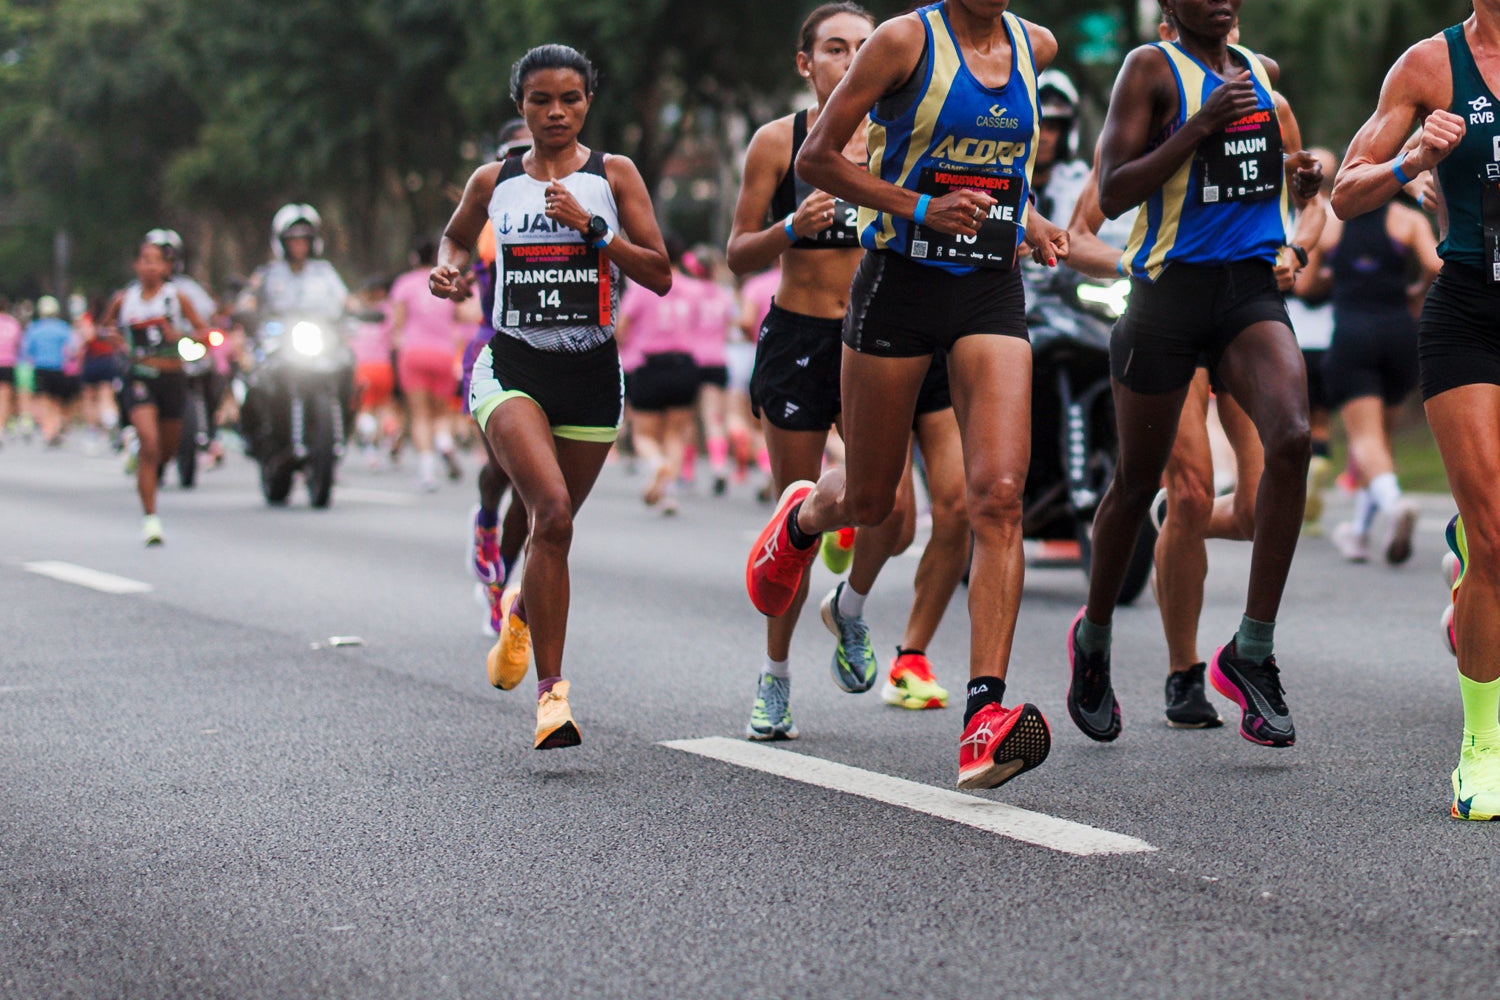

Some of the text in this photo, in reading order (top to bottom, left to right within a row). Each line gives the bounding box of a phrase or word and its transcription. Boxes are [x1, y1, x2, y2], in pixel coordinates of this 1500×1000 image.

[976, 115, 1019, 129] CASSEMS
[1469, 111, 1495, 125] RVB
[930, 134, 1026, 166] ACORP
[1224, 137, 1267, 156] NAUM
[1239, 160, 1258, 180] 15
[934, 172, 1010, 190] VENUSWOMEN'S
[506, 269, 599, 284] FRANCIANE
[537, 289, 561, 308] 14
